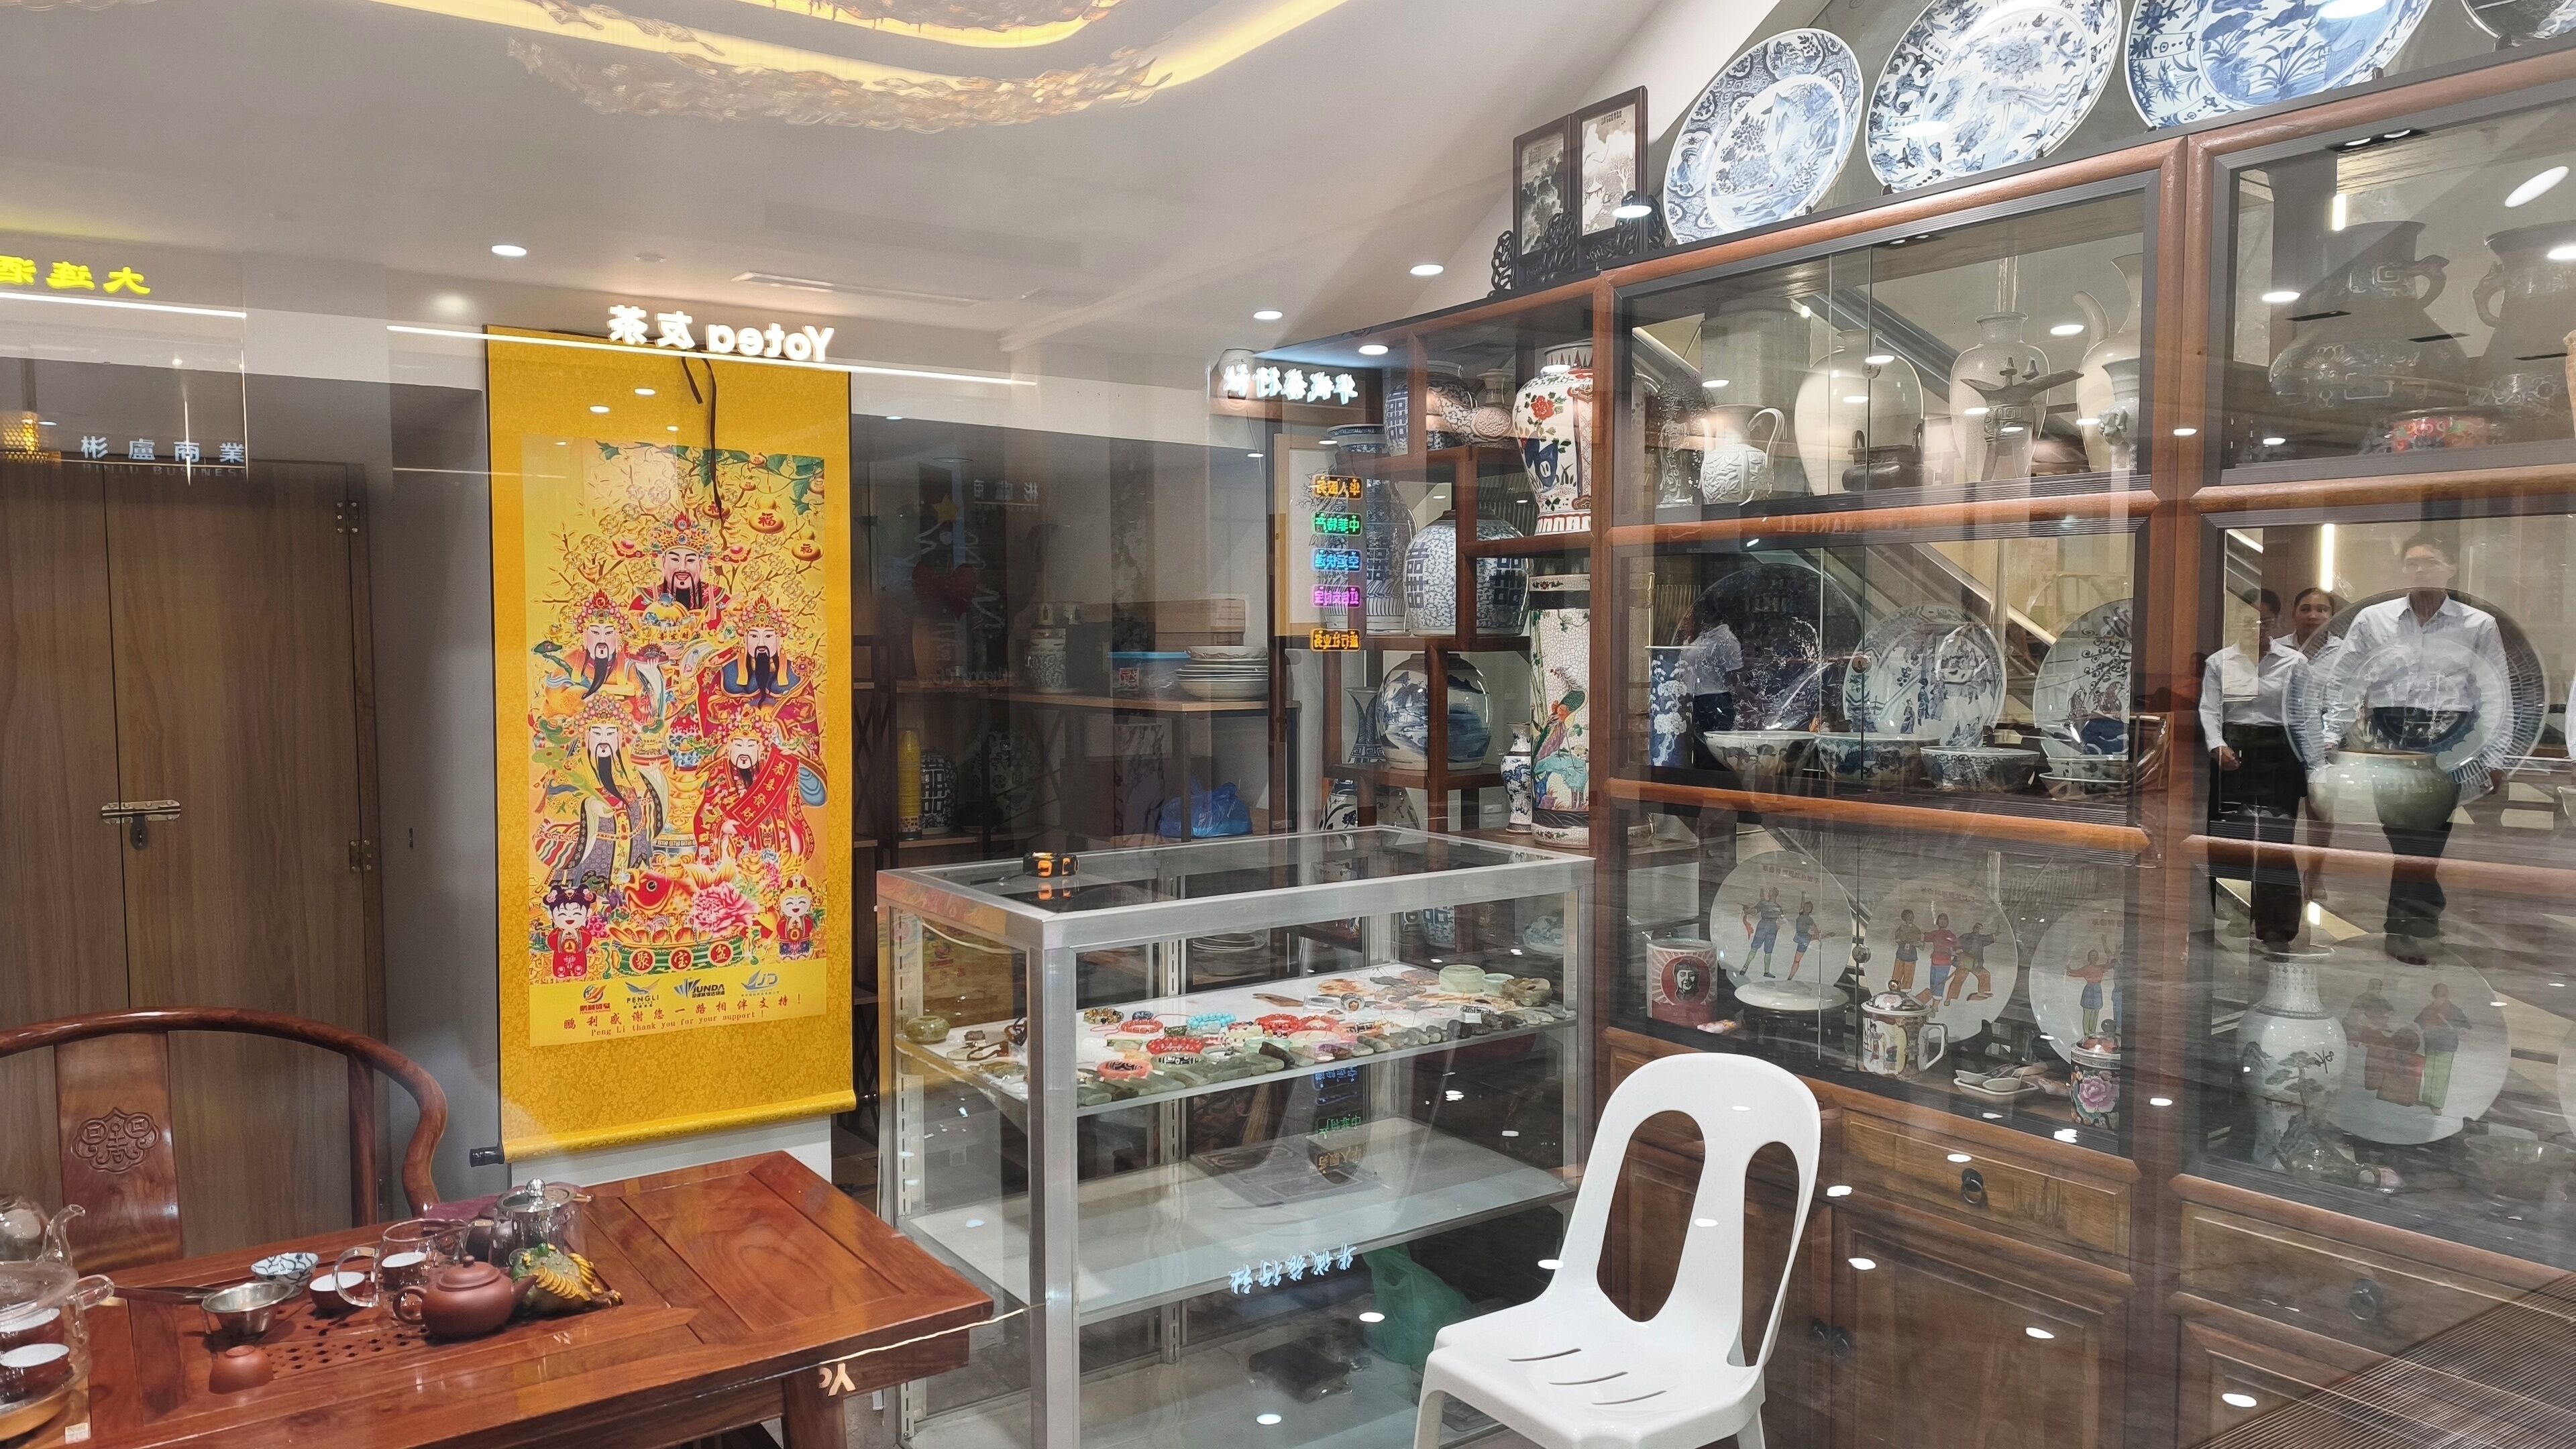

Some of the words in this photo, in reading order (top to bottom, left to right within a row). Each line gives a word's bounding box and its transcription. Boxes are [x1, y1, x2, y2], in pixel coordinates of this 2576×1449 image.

[635, 945, 729, 969] 聚宝盆
[627, 994, 659, 1004] PENGLI
[591, 1028, 612, 1037] Peng
[632, 1022, 656, 1031] thank
[661, 1021, 676, 1030] you
[680, 1017, 694, 1026] for
[698, 1015, 718, 1024] your
